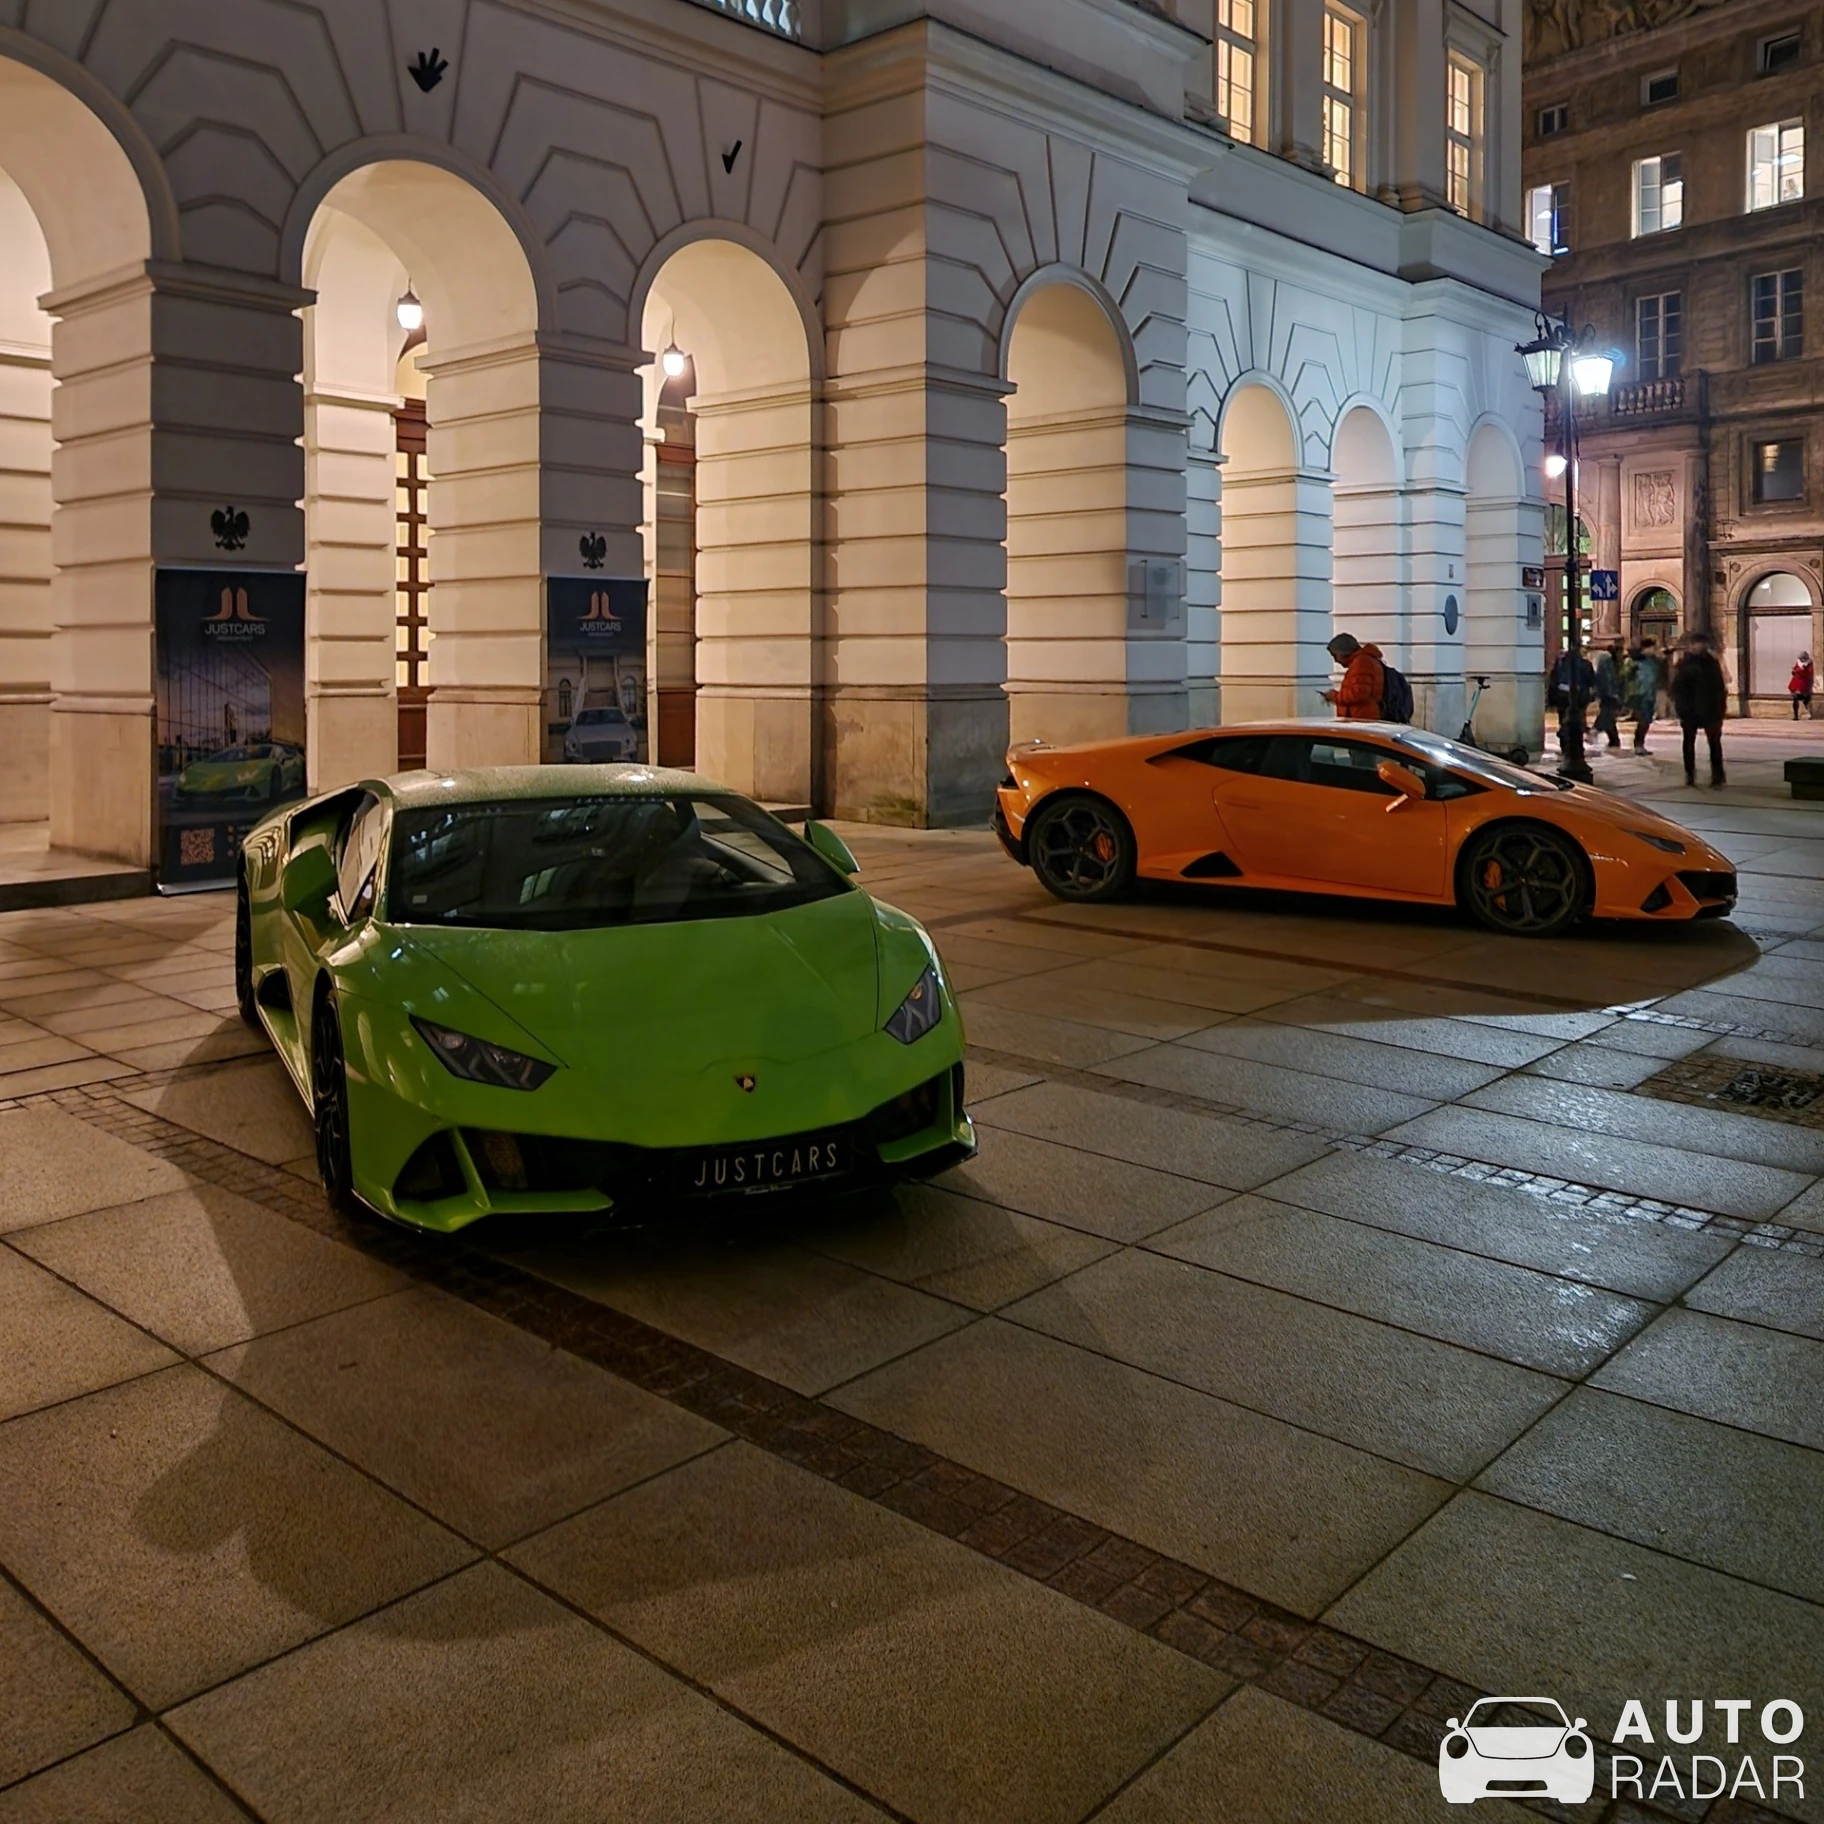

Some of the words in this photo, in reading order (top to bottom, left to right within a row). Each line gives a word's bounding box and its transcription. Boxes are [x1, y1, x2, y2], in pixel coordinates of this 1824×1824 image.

[205, 623, 266, 635] JUSTCARS
[580, 621, 622, 632] JUSTCARS
[694, 1143, 837, 1187] JUSTCARS
